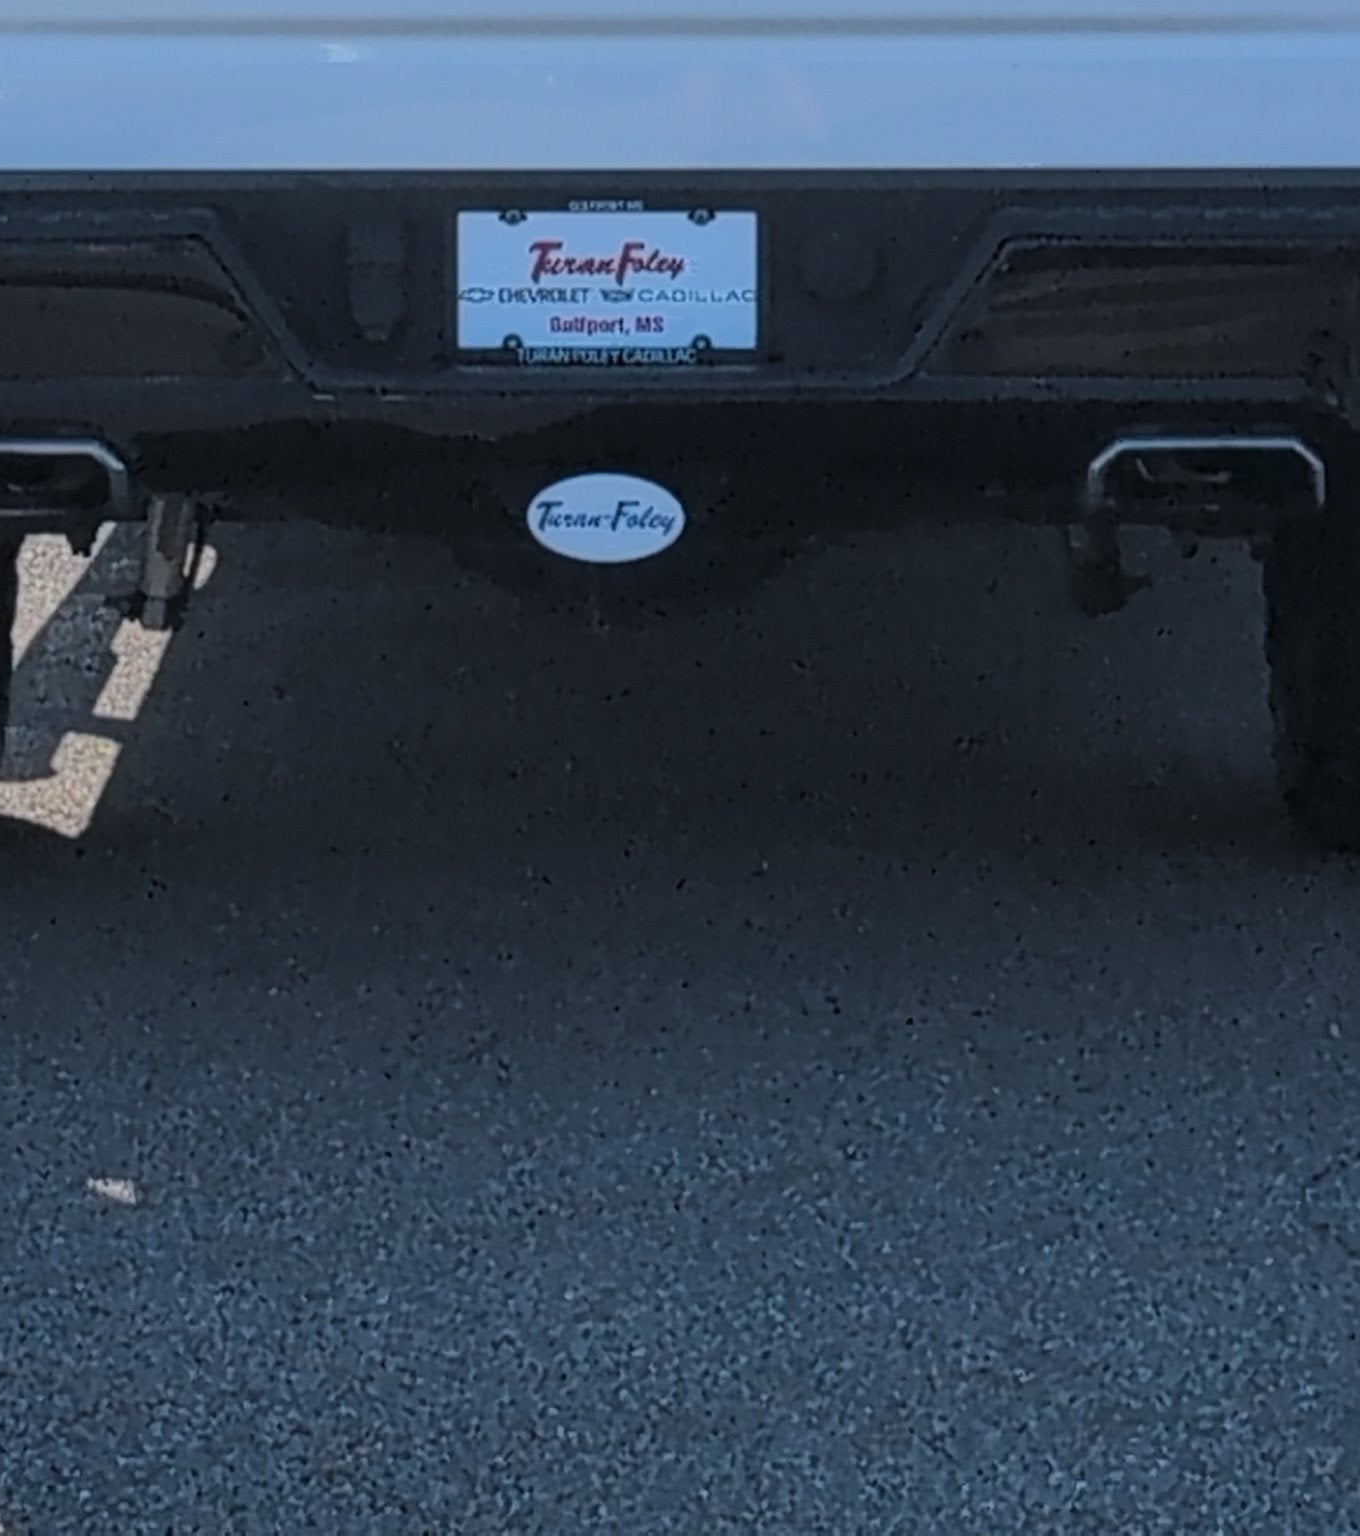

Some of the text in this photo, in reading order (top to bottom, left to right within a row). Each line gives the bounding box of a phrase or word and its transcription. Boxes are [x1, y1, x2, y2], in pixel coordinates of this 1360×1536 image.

[498, 287, 757, 304] CHEVROLET CADILLAC
[549, 316, 664, 336] Gulfport, MS
